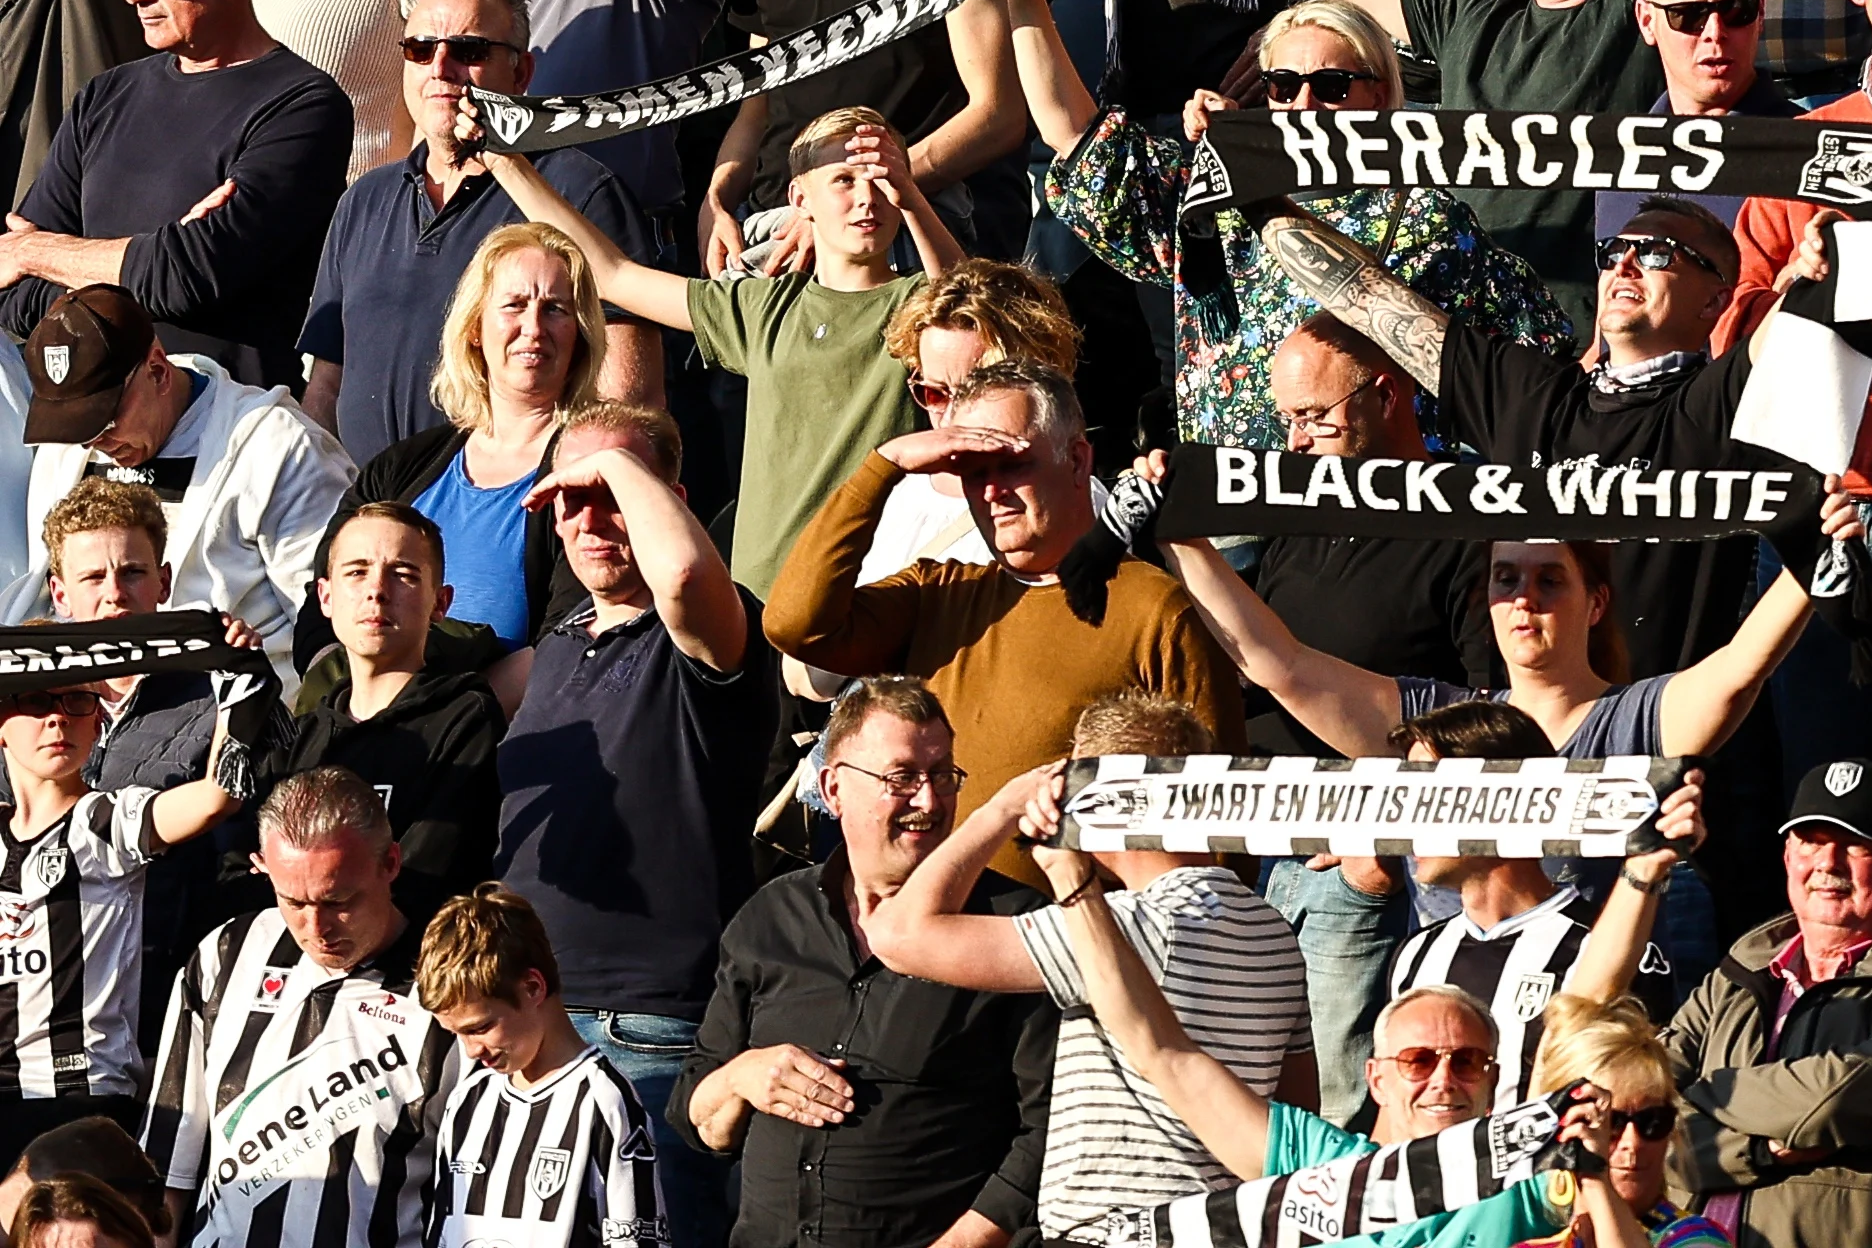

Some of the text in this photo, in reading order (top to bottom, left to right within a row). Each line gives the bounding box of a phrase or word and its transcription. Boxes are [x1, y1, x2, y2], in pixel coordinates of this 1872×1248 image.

[1272, 110, 1725, 192] HERACLES
[1215, 445, 1794, 523] BLACK & WHITE
[1161, 782, 1267, 823] ZWART
[1269, 784, 1310, 823] EN
[1314, 784, 1373, 823] WIT
[1374, 785, 1409, 823] IS
[1411, 784, 1562, 825] HERACLES
[358, 1001, 406, 1026] Beltona
[1284, 1199, 1340, 1238] asito
